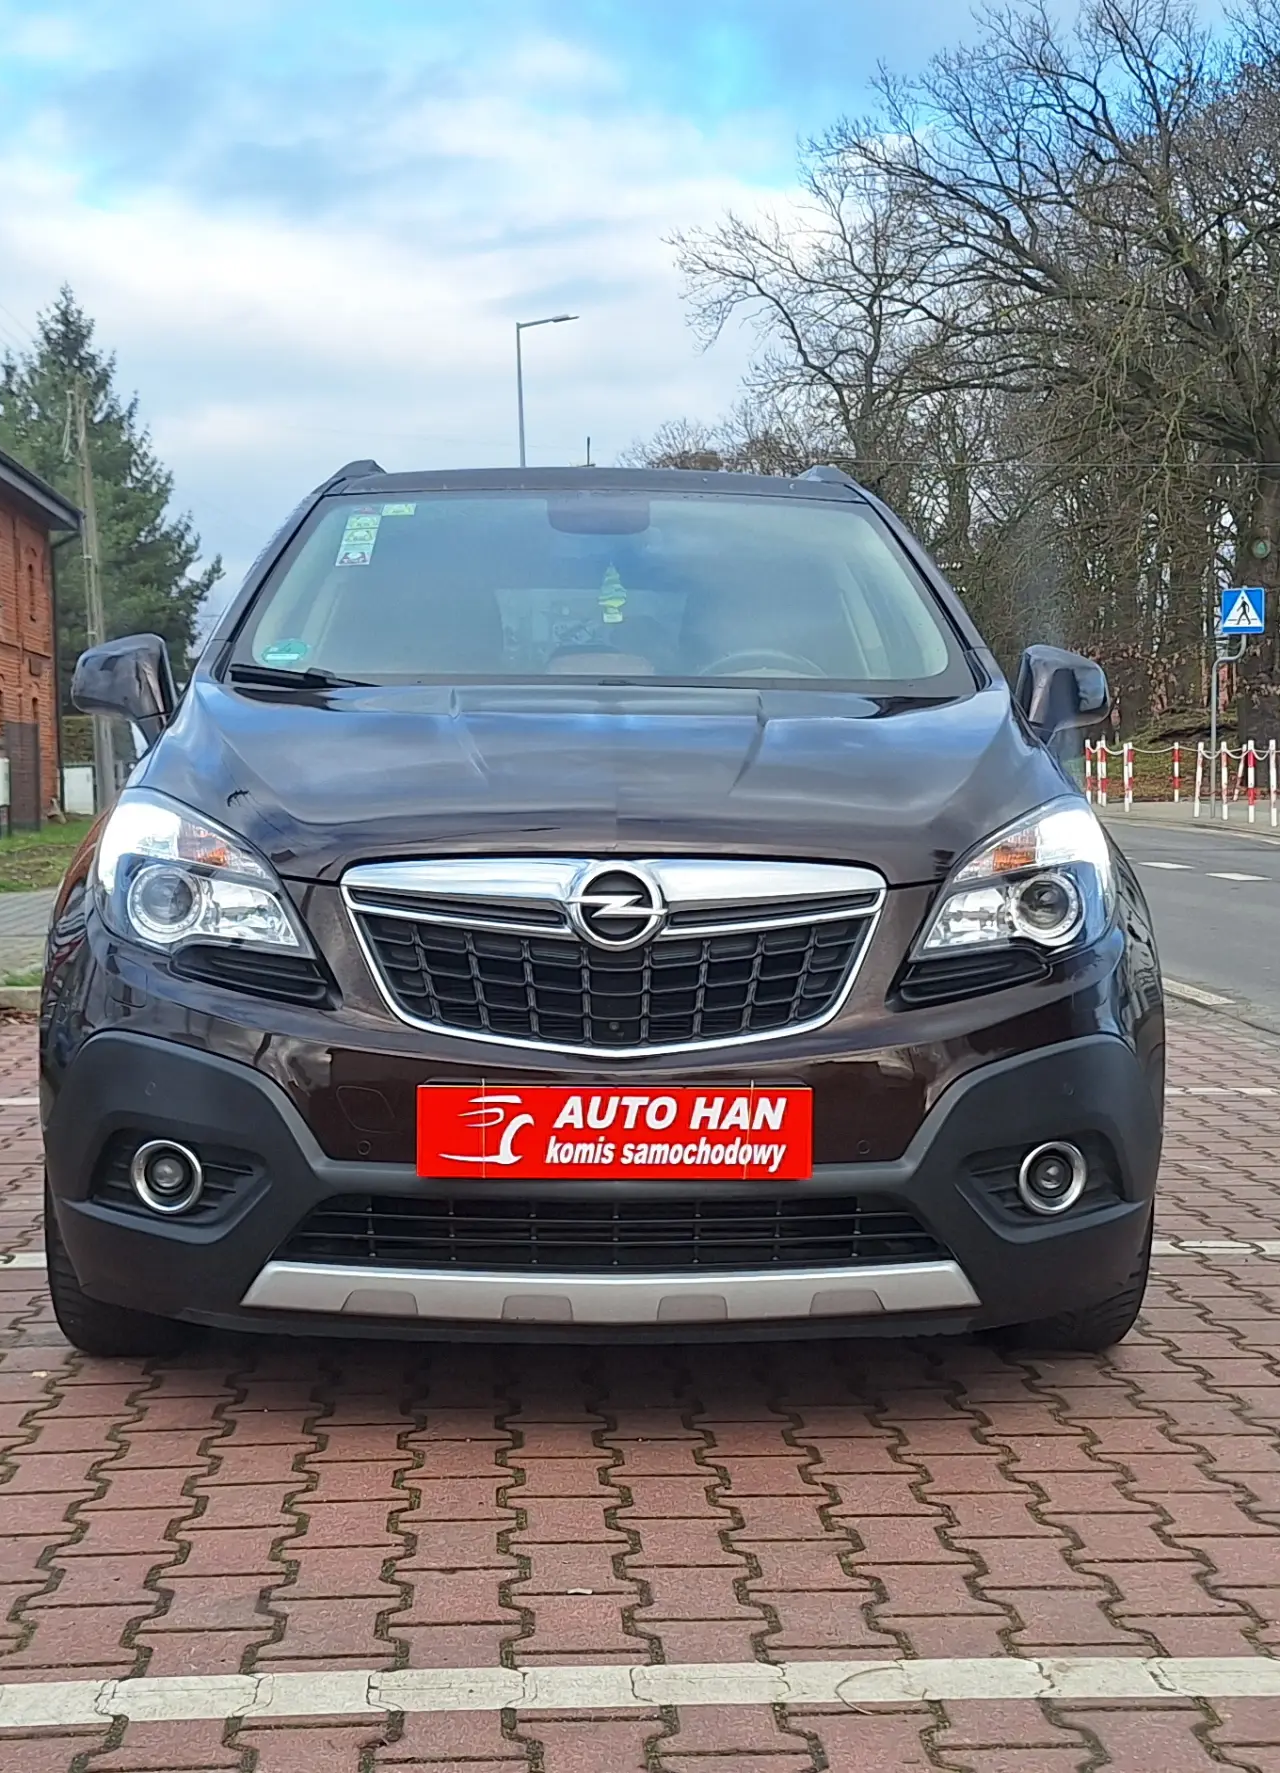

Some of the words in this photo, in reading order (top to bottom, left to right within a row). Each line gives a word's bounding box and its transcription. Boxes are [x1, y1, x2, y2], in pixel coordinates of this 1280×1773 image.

[552, 1095, 677, 1131] AUTO
[688, 1096, 788, 1131] HAN
[545, 1135, 615, 1165] komis
[620, 1136, 787, 1173] samochodowy
